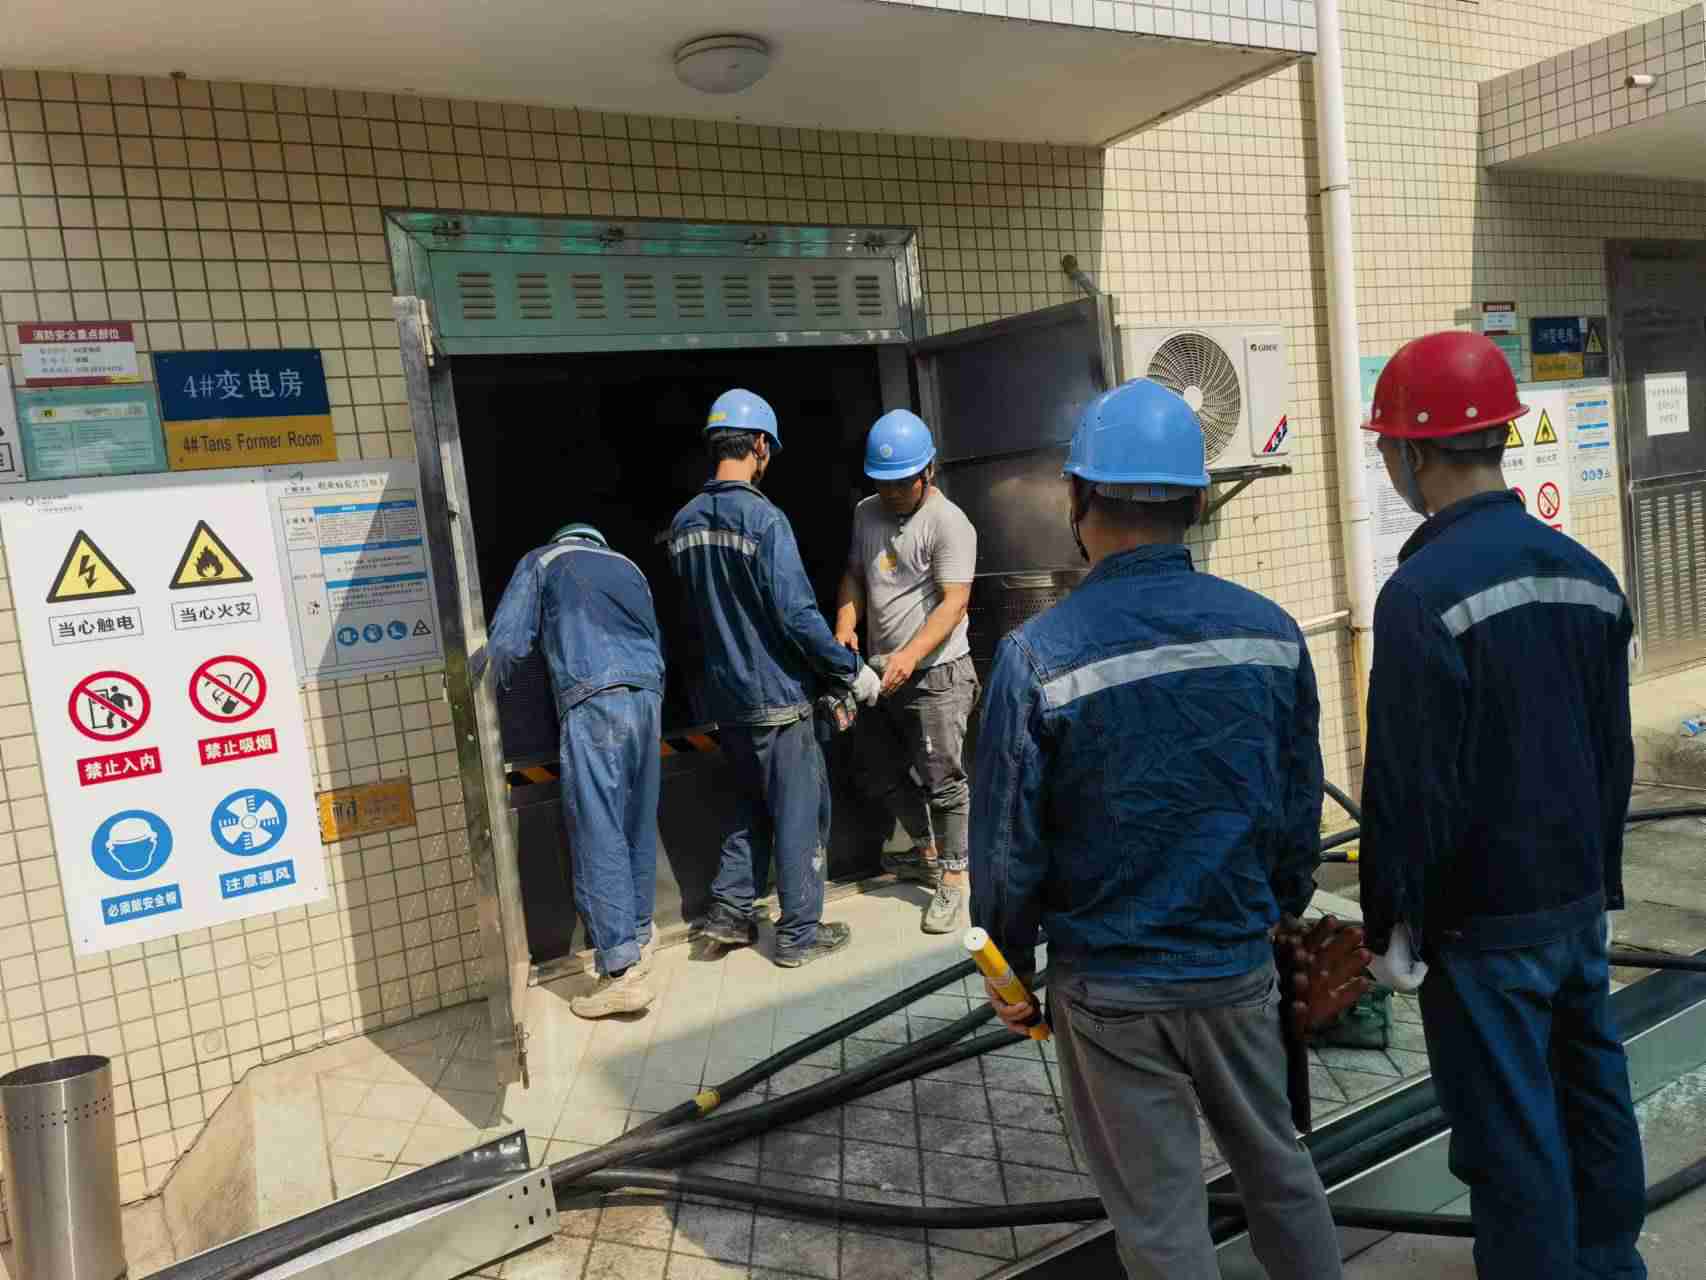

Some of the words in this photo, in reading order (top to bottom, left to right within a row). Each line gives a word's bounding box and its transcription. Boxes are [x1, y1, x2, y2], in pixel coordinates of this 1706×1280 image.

[183, 368, 305, 400] 4#变电房
[236, 432, 282, 451] Former
[287, 430, 322, 448] Room
[58, 614, 136, 639] 当心触电
[180, 601, 253, 624] 当心火灾
[204, 733, 273, 761] 禁止吸烟
[84, 751, 157, 781] 禁止入内
[225, 865, 292, 893] 注意通风
